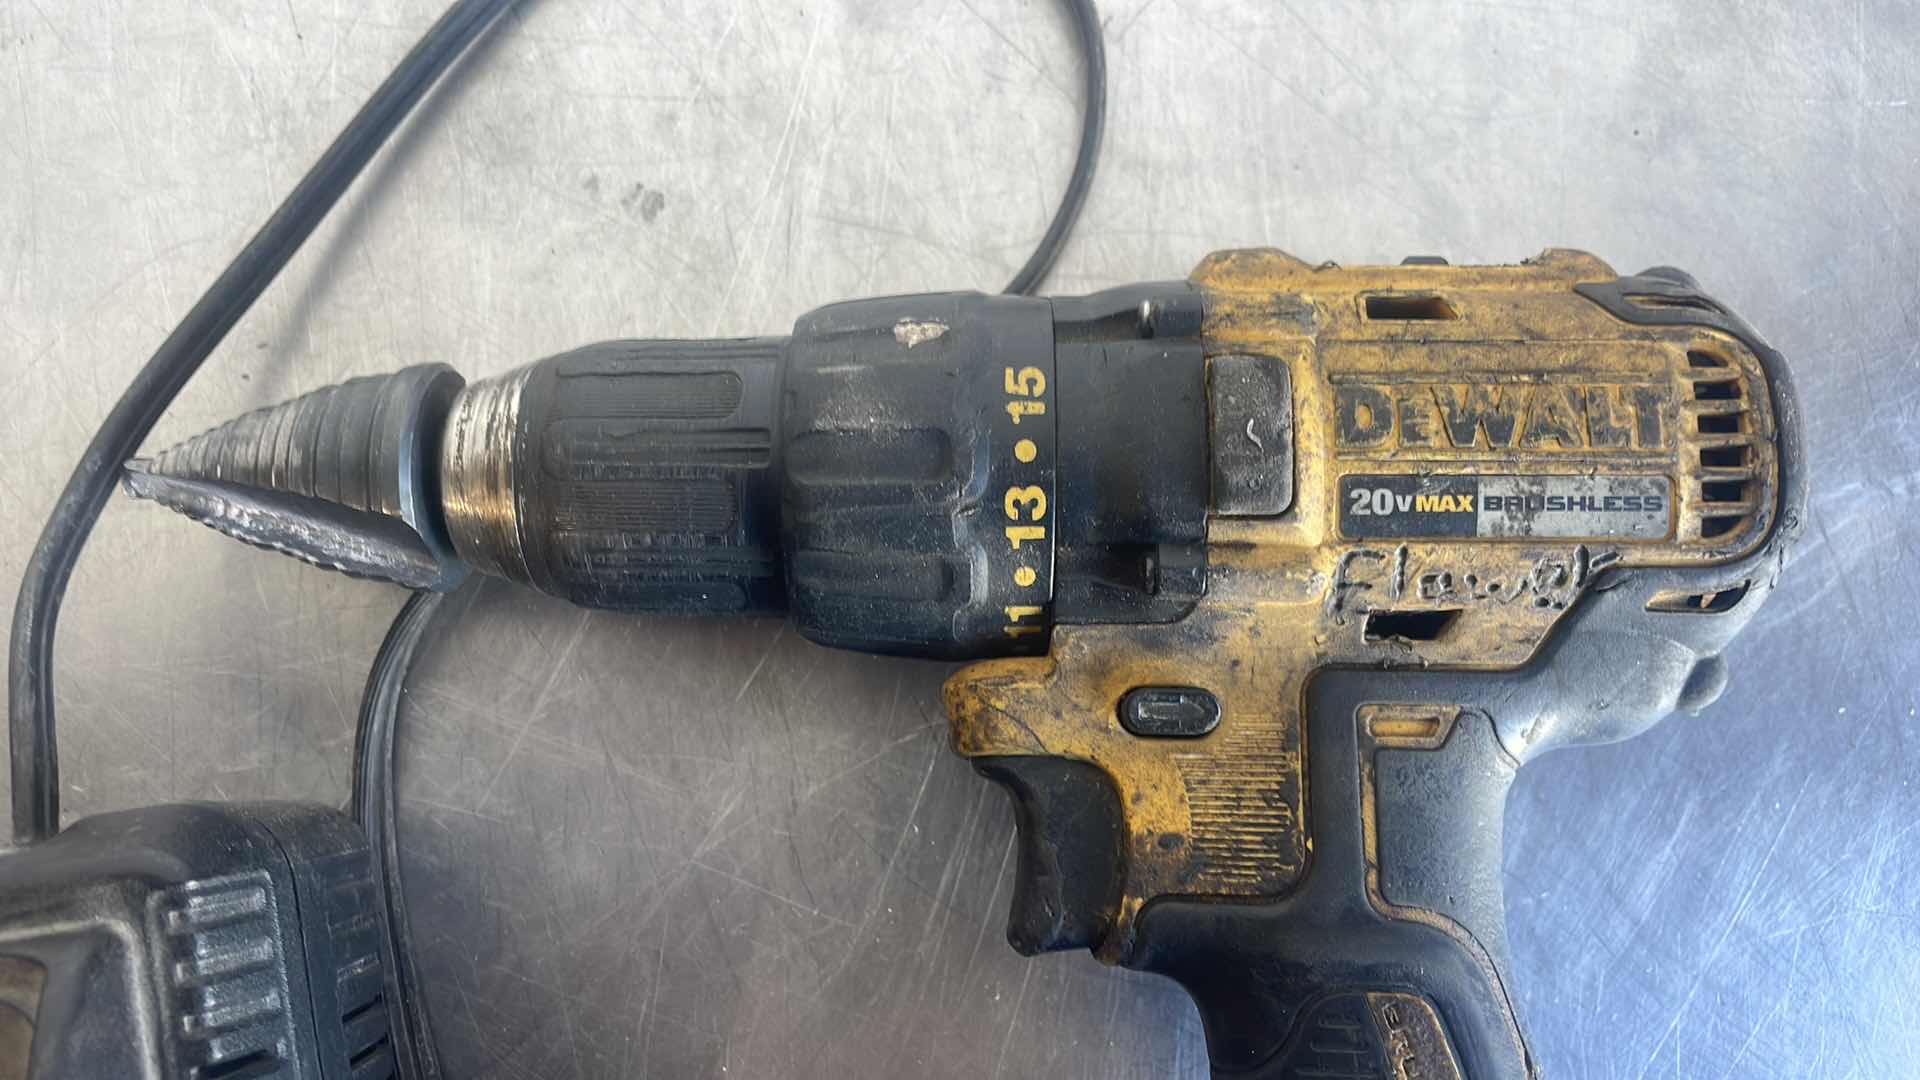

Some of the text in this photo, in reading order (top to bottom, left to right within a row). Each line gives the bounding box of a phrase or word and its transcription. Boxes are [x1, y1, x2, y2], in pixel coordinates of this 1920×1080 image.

[1004, 365, 1047, 425] 15
[1334, 383, 1674, 449] DEWALT
[1004, 485, 1047, 550] 13
[1415, 495, 1474, 513] MAX
[1483, 496, 1664, 513] BRUSHLESS
[1003, 605, 1043, 638] 11
